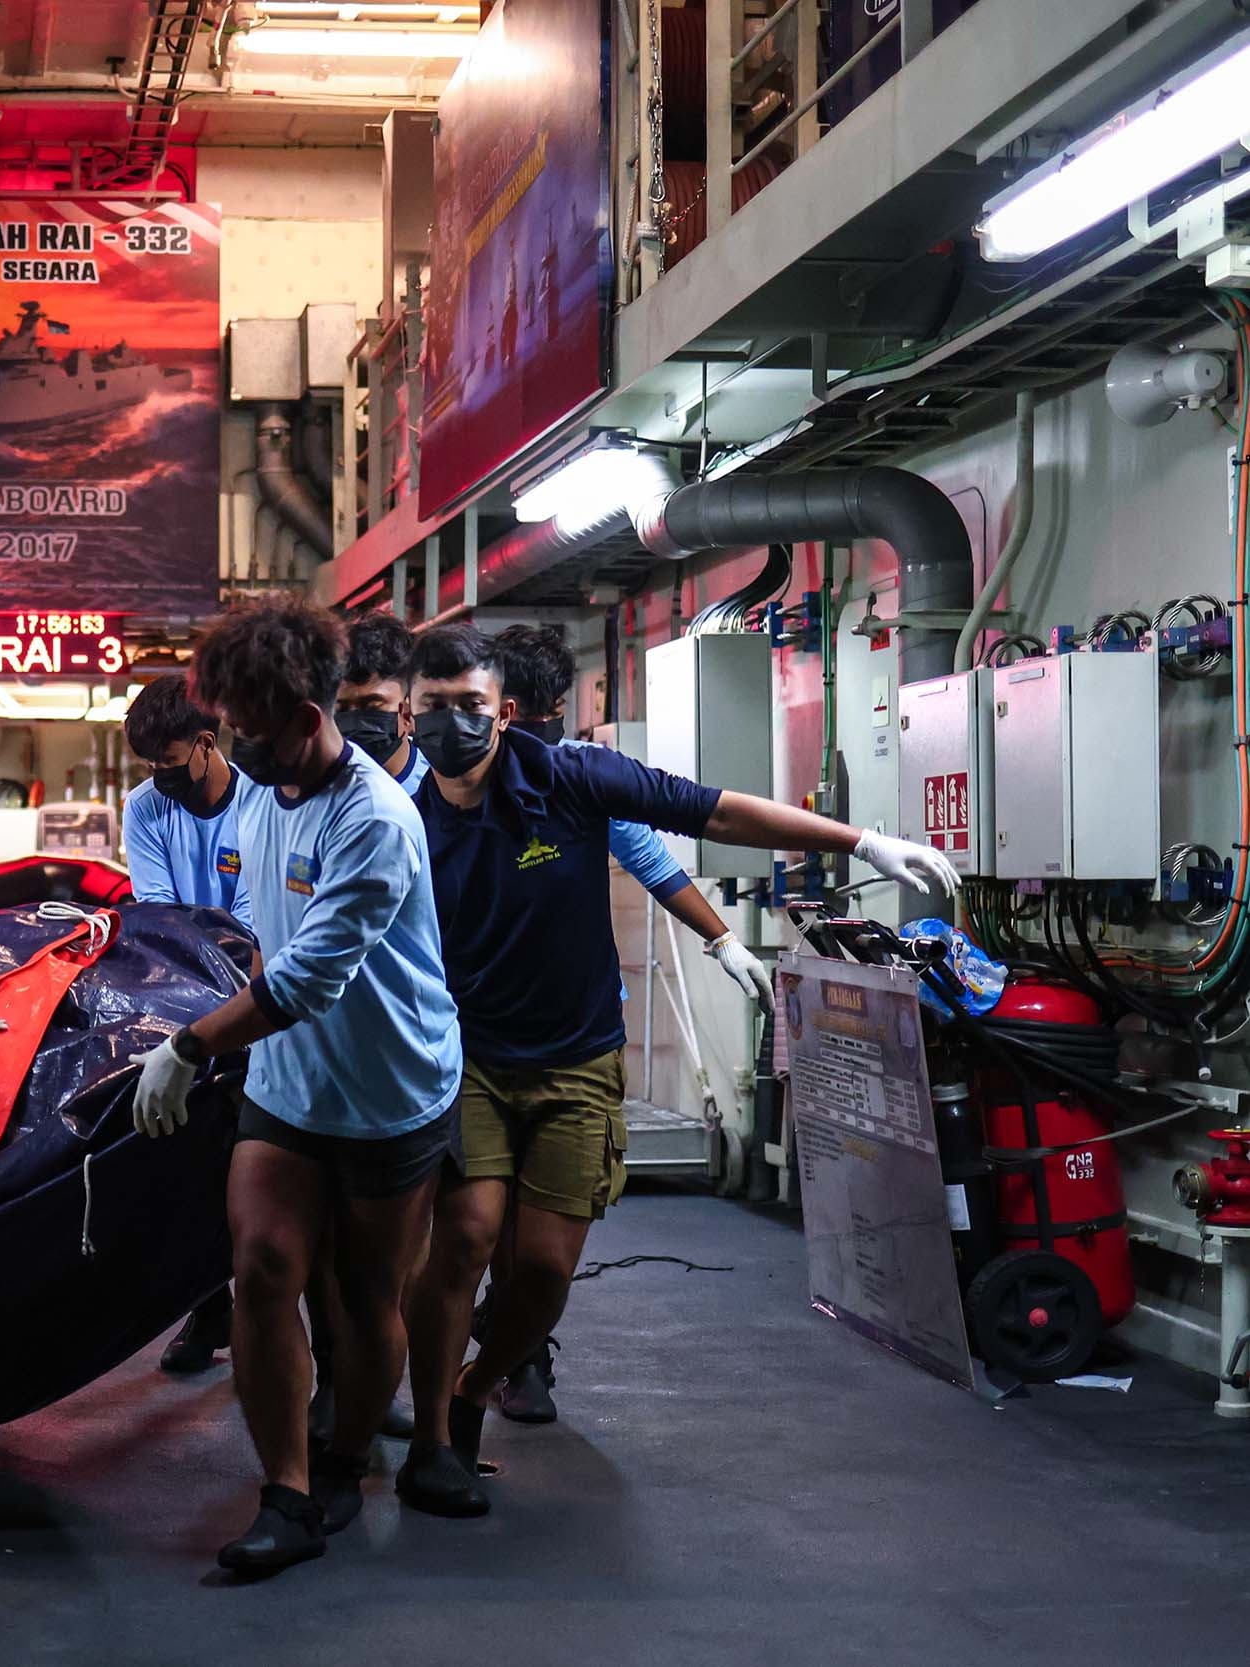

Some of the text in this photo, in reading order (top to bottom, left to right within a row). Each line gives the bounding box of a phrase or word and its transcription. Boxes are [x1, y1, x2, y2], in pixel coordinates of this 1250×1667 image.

[38, 222, 94, 252] RAI
[127, 224, 191, 254] 332
[2, 260, 99, 283] SEGARA
[98, 636, 123, 673] 3
